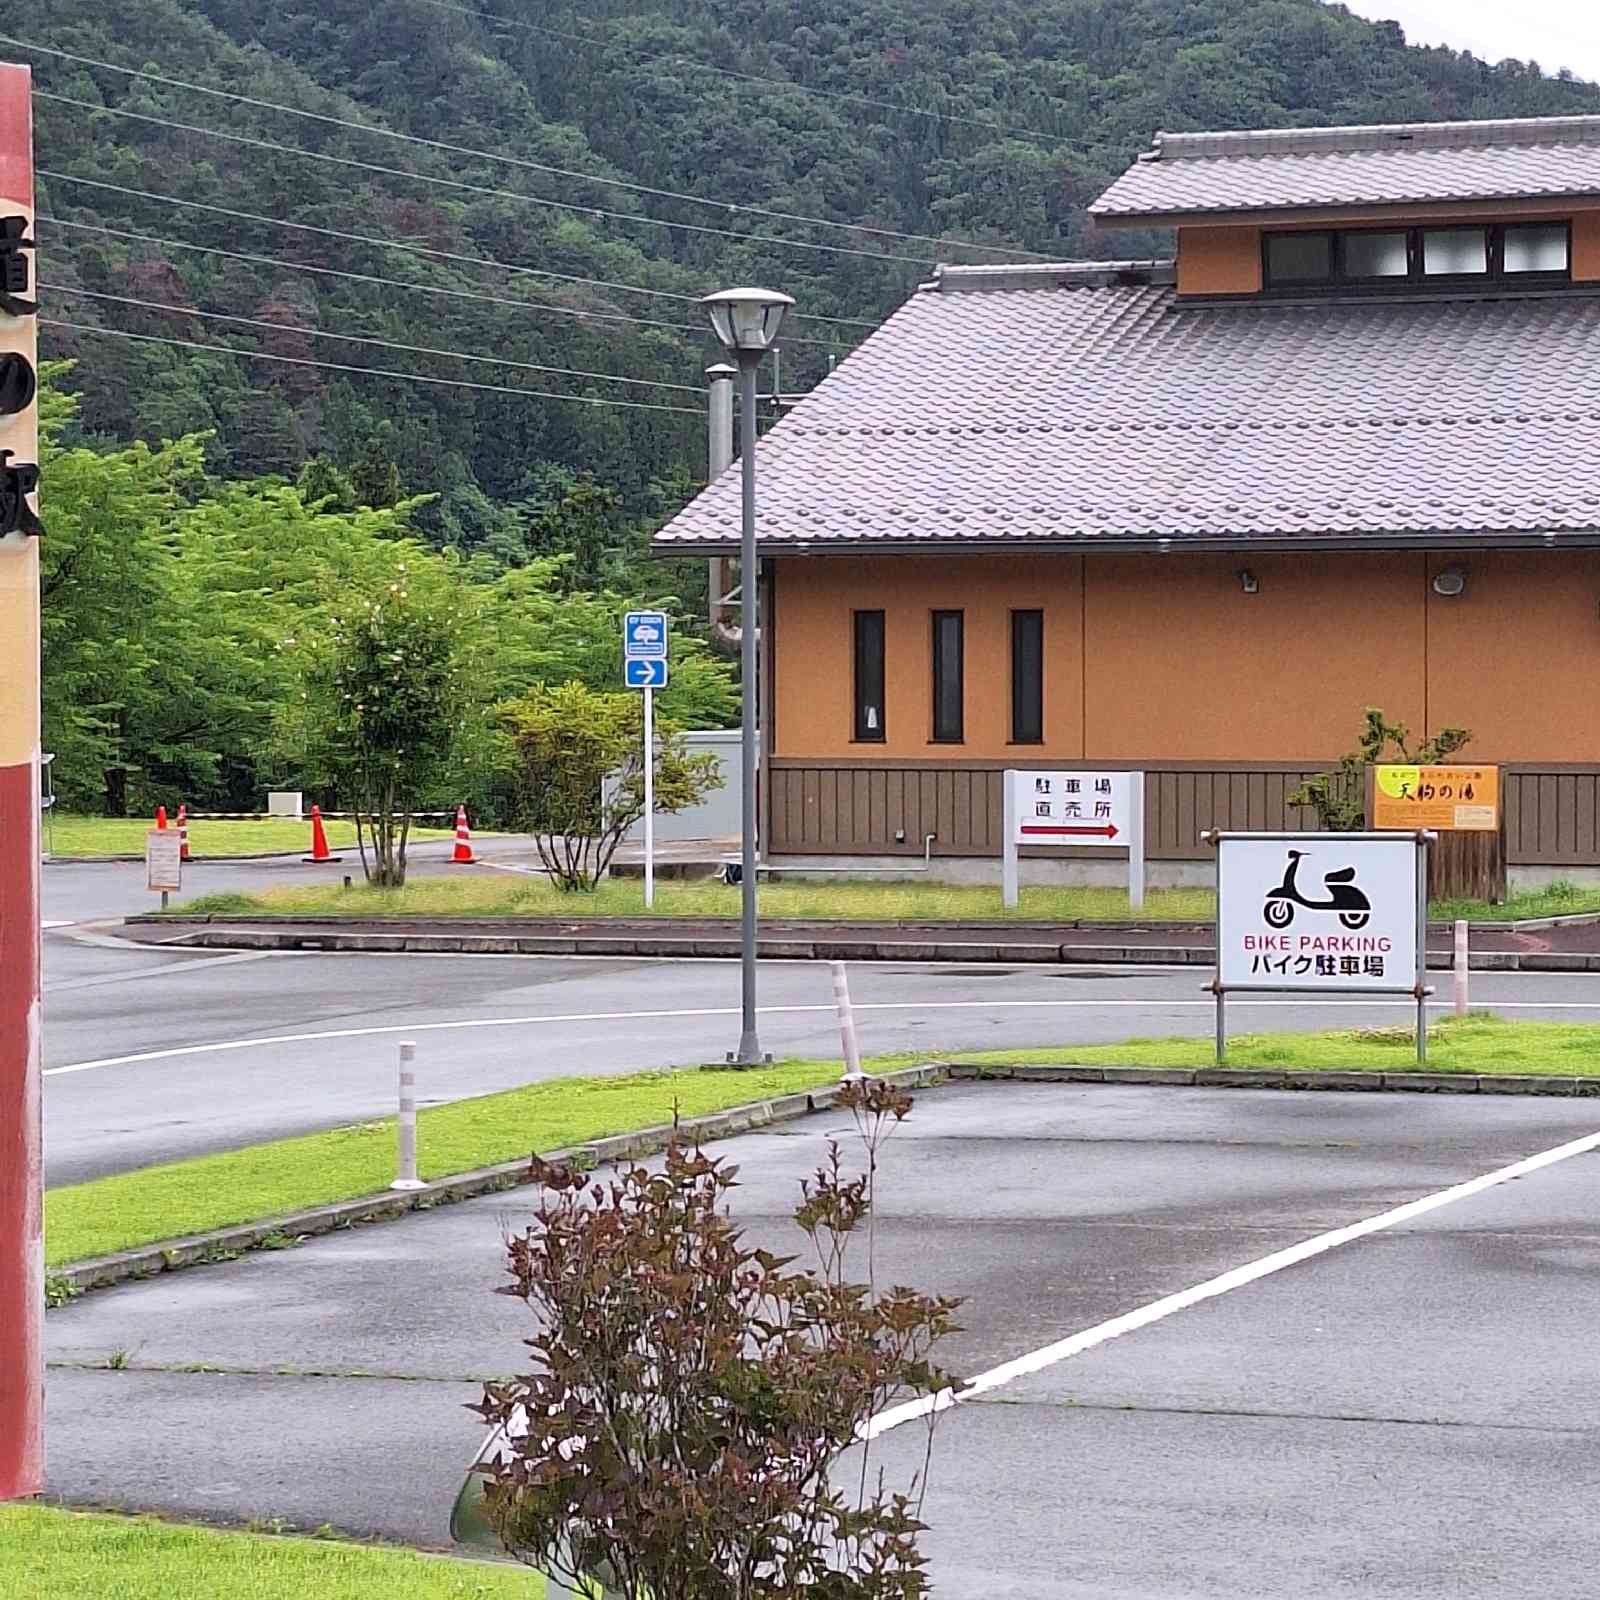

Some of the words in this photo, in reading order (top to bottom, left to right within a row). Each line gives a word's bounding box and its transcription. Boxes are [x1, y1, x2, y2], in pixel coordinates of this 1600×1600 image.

[1034, 777, 1112, 795] 駐車場
[1035, 801, 1112, 818] 直売所
[1244, 935, 1292, 950] BIKE
[1300, 936, 1392, 952] PARKING
[1251, 955, 1385, 977] バイク駐車場
